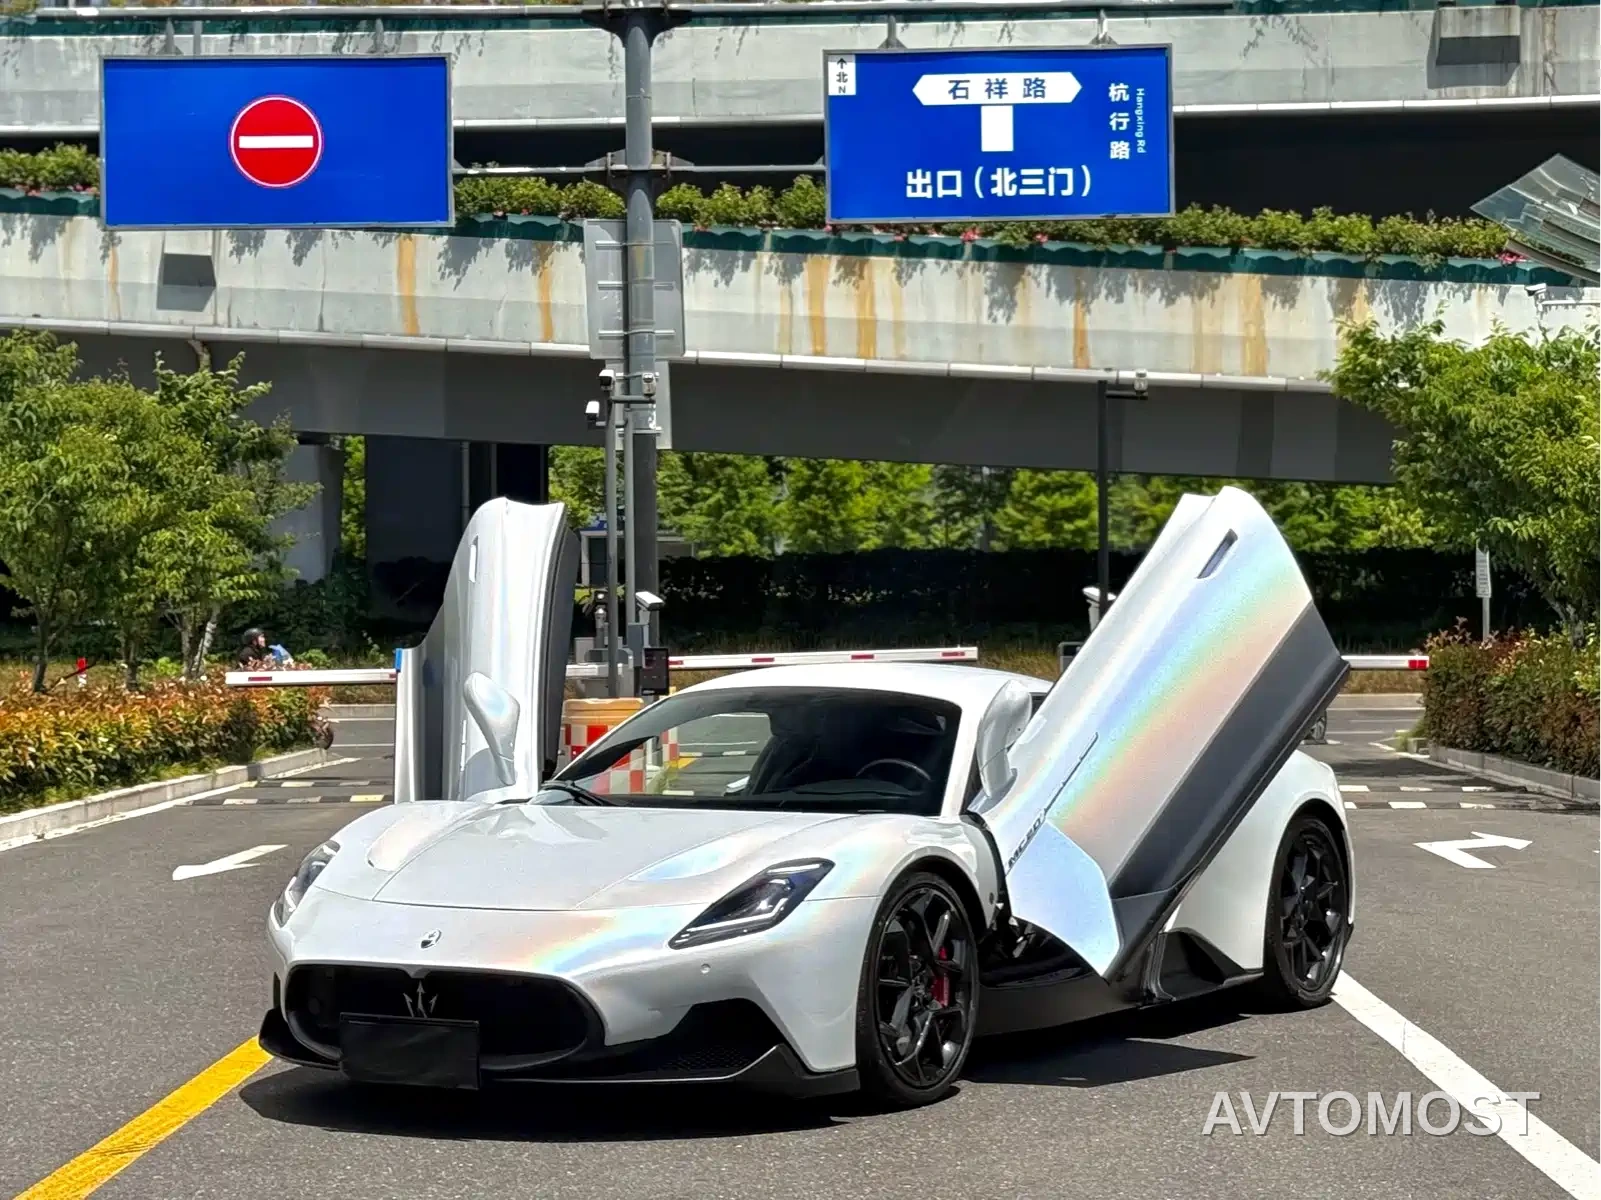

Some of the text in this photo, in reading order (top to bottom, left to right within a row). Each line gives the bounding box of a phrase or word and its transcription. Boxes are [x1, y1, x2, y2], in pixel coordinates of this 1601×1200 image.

[836, 71, 848, 83] 北
[838, 85, 846, 94] N
[948, 77, 1047, 100] 石祥路
[1108, 82, 1130, 160] 杭行路
[1134, 87, 1147, 154] Hangxing Rd
[905, 164, 1091, 199] 出口（北三门）
